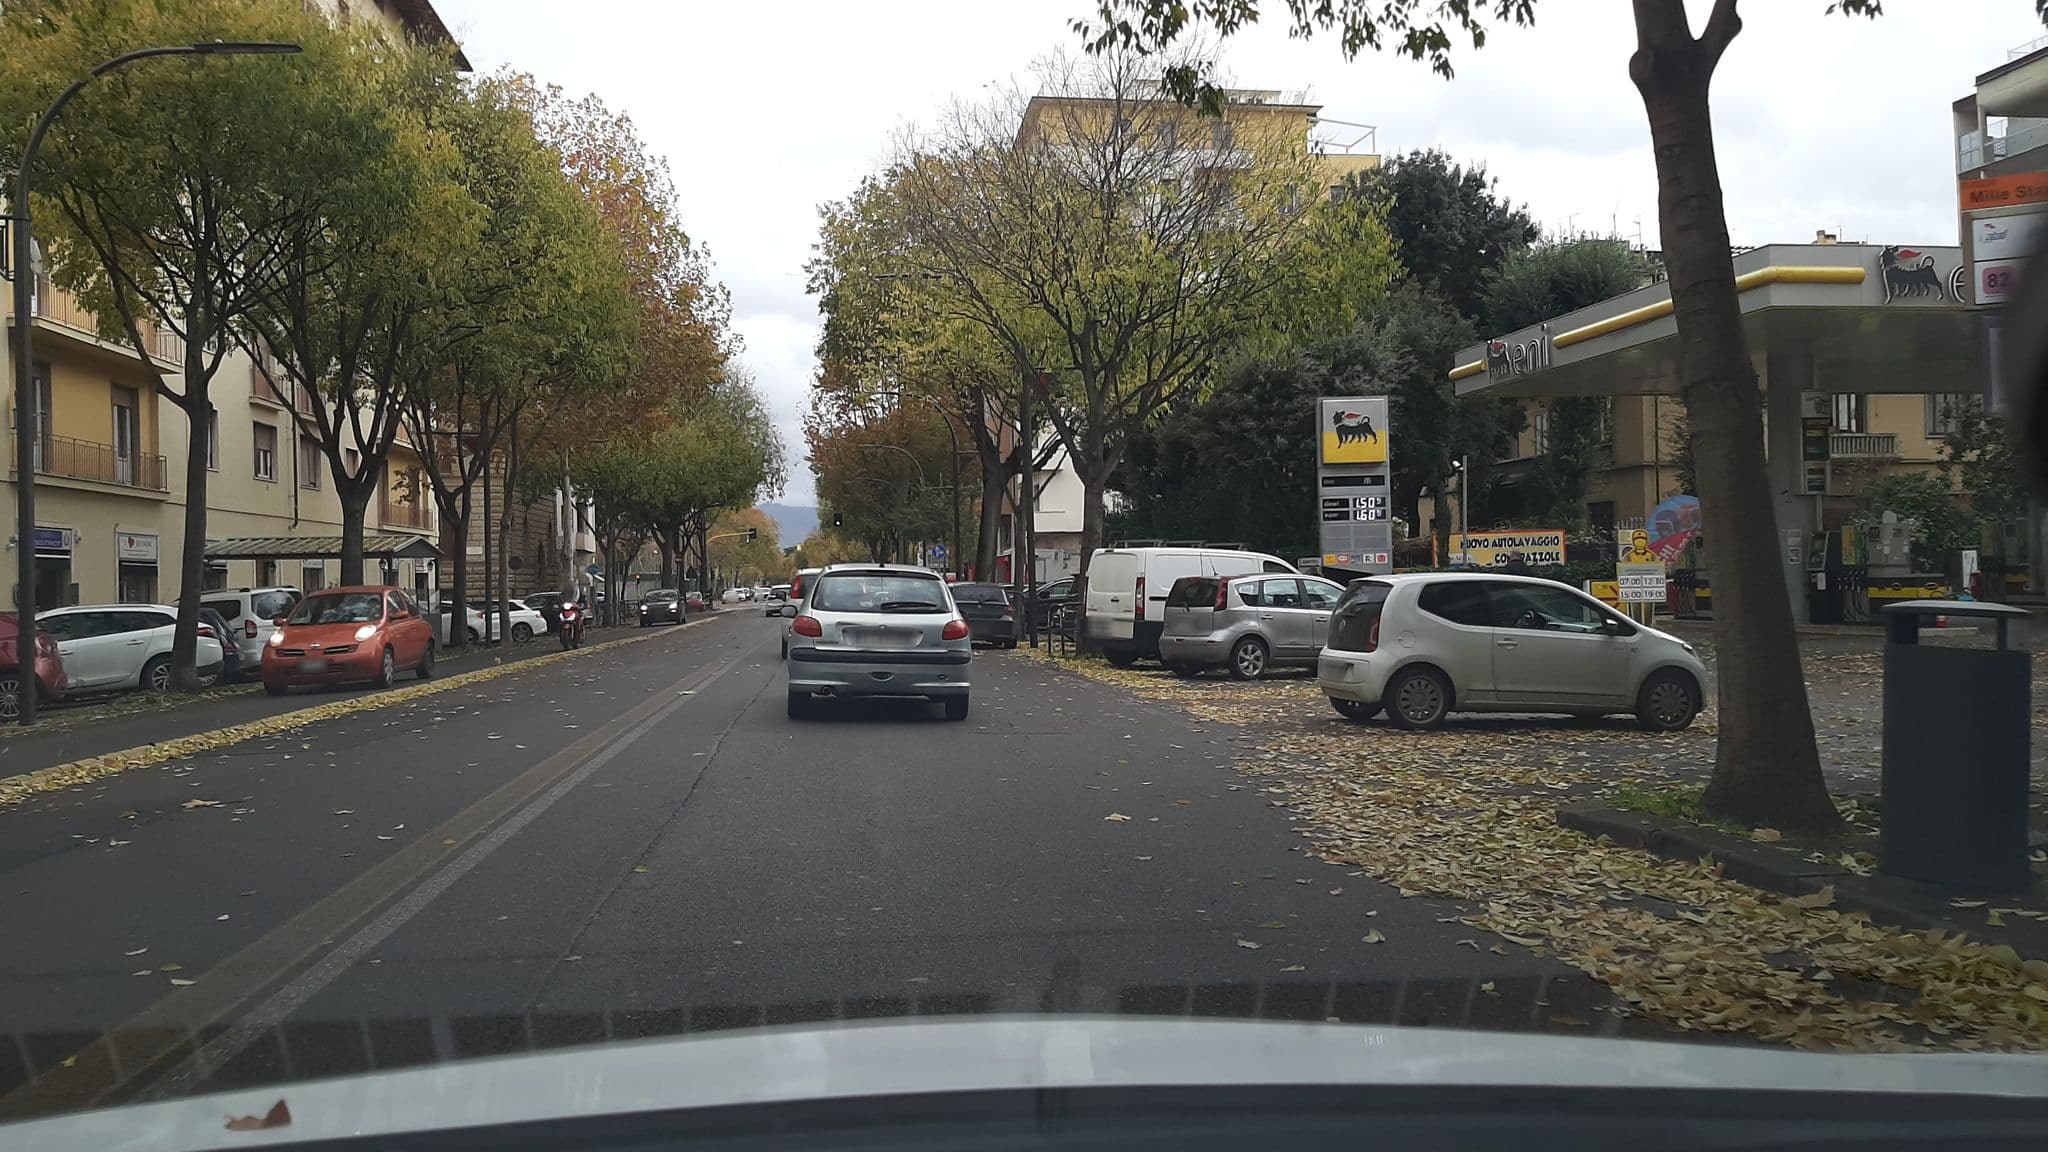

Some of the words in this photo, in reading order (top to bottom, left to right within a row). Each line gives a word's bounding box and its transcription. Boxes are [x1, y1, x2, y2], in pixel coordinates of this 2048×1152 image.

[1969, 191, 2009, 203] Mille
[1512, 323, 1549, 376] eni
[1491, 536, 1560, 548] AUTOLAVAGGIO
